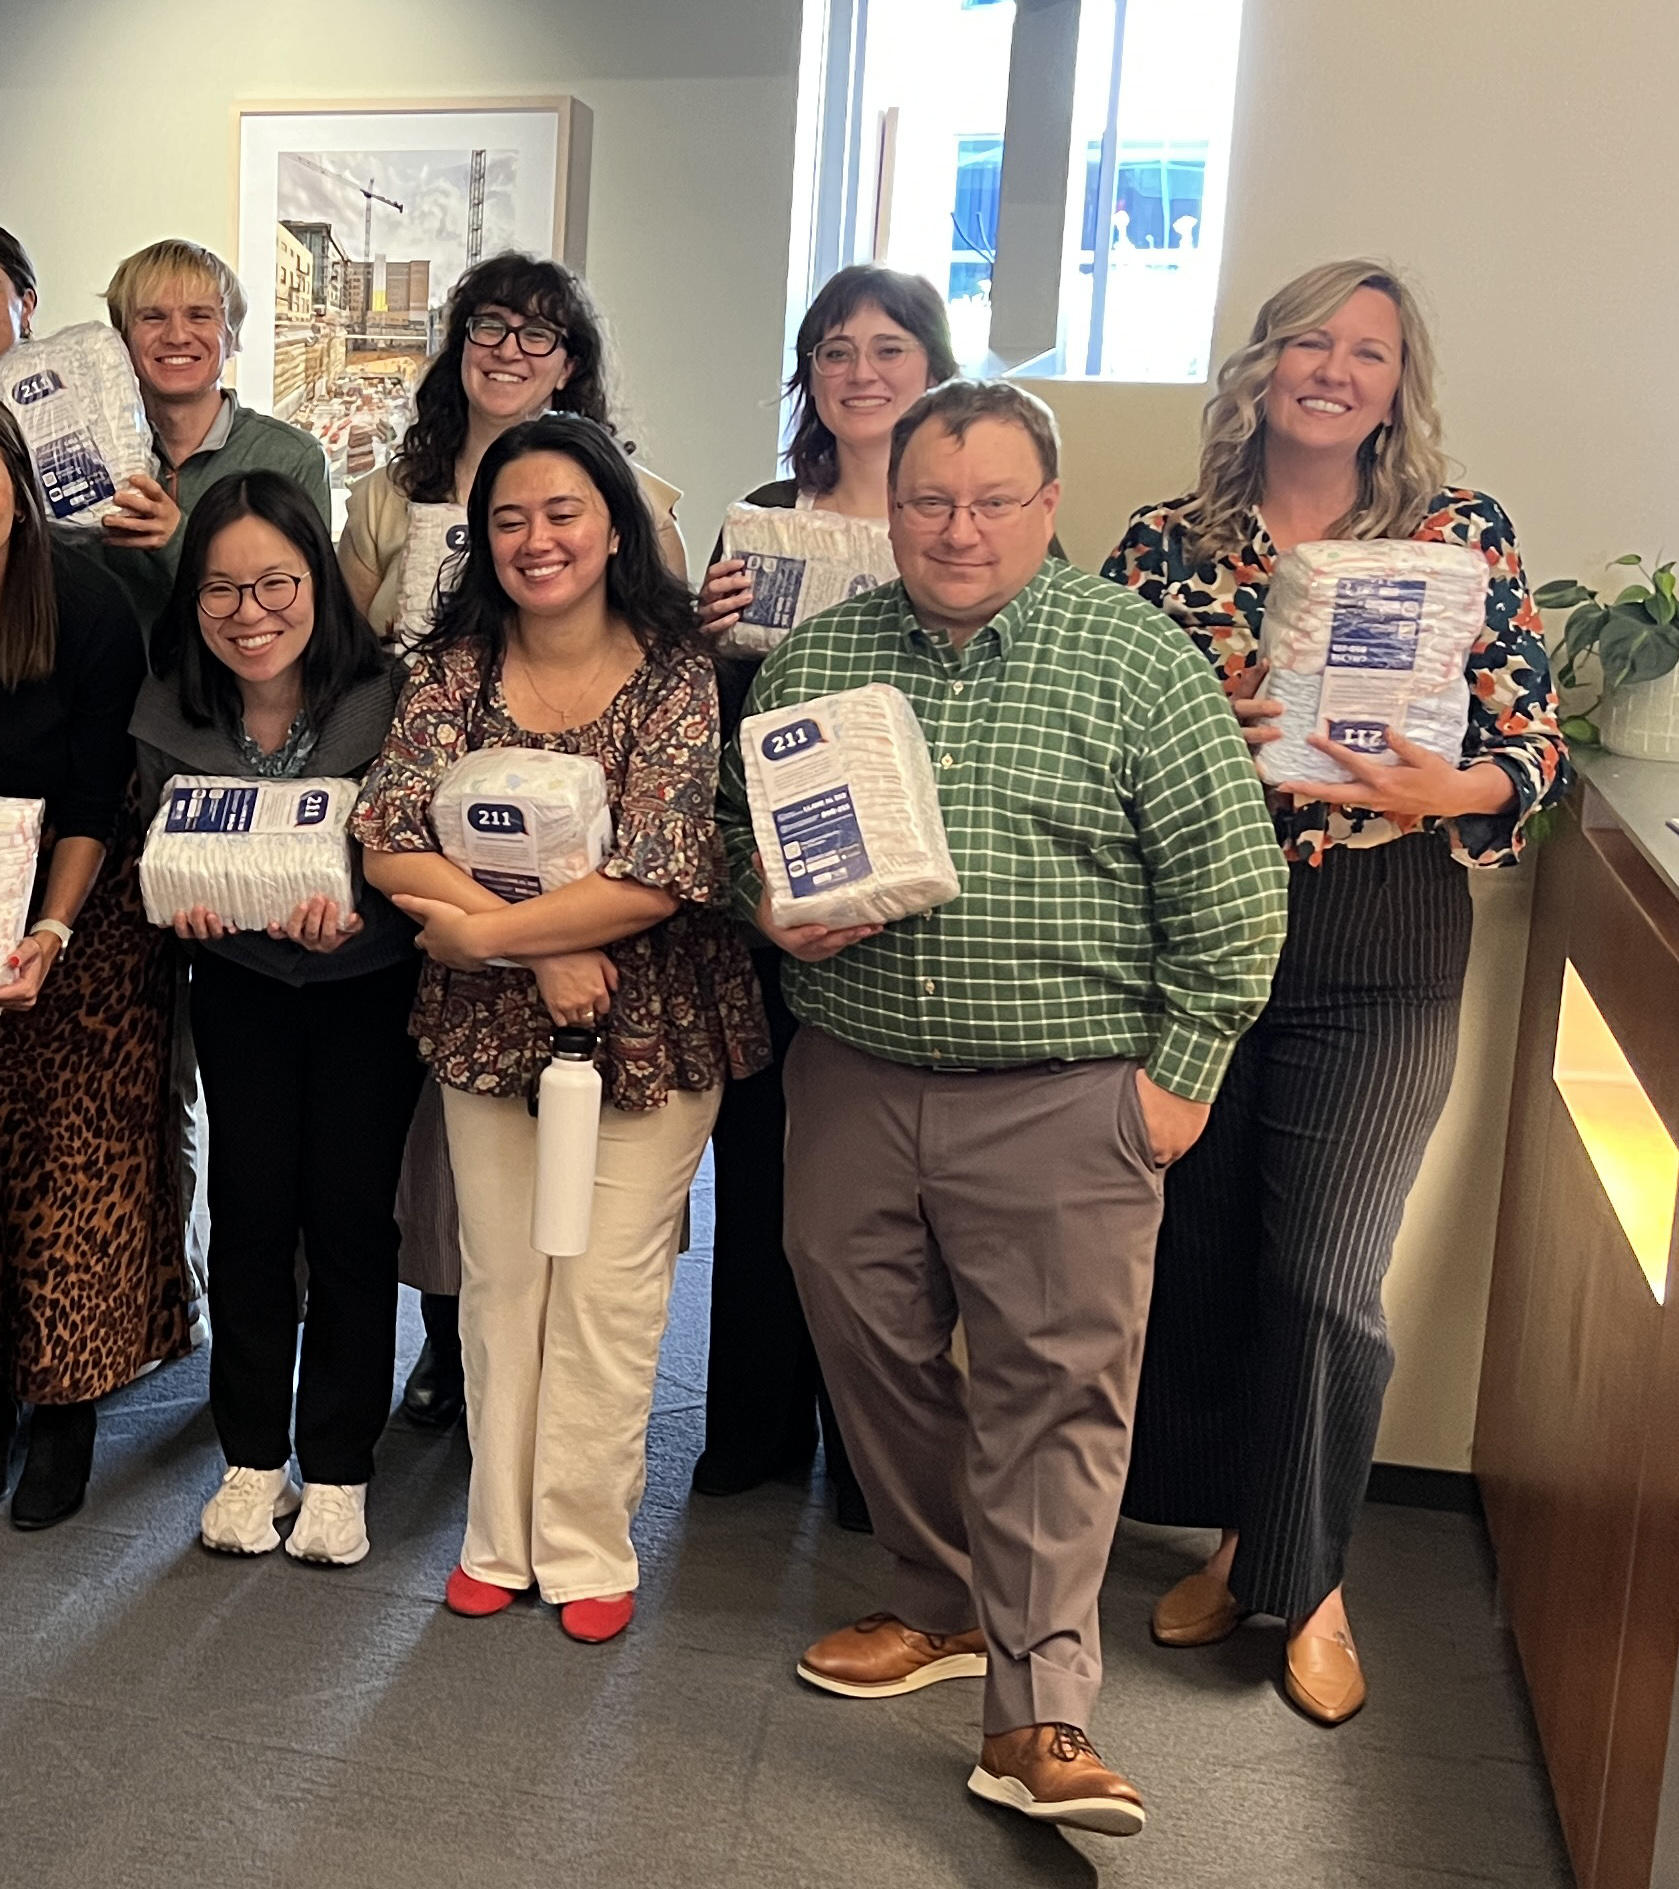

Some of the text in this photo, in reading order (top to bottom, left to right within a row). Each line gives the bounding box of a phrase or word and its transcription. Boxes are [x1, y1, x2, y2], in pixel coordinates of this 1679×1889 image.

[772, 727, 808, 753] 211
[304, 796, 322, 817] 211
[478, 810, 511, 826] 211
